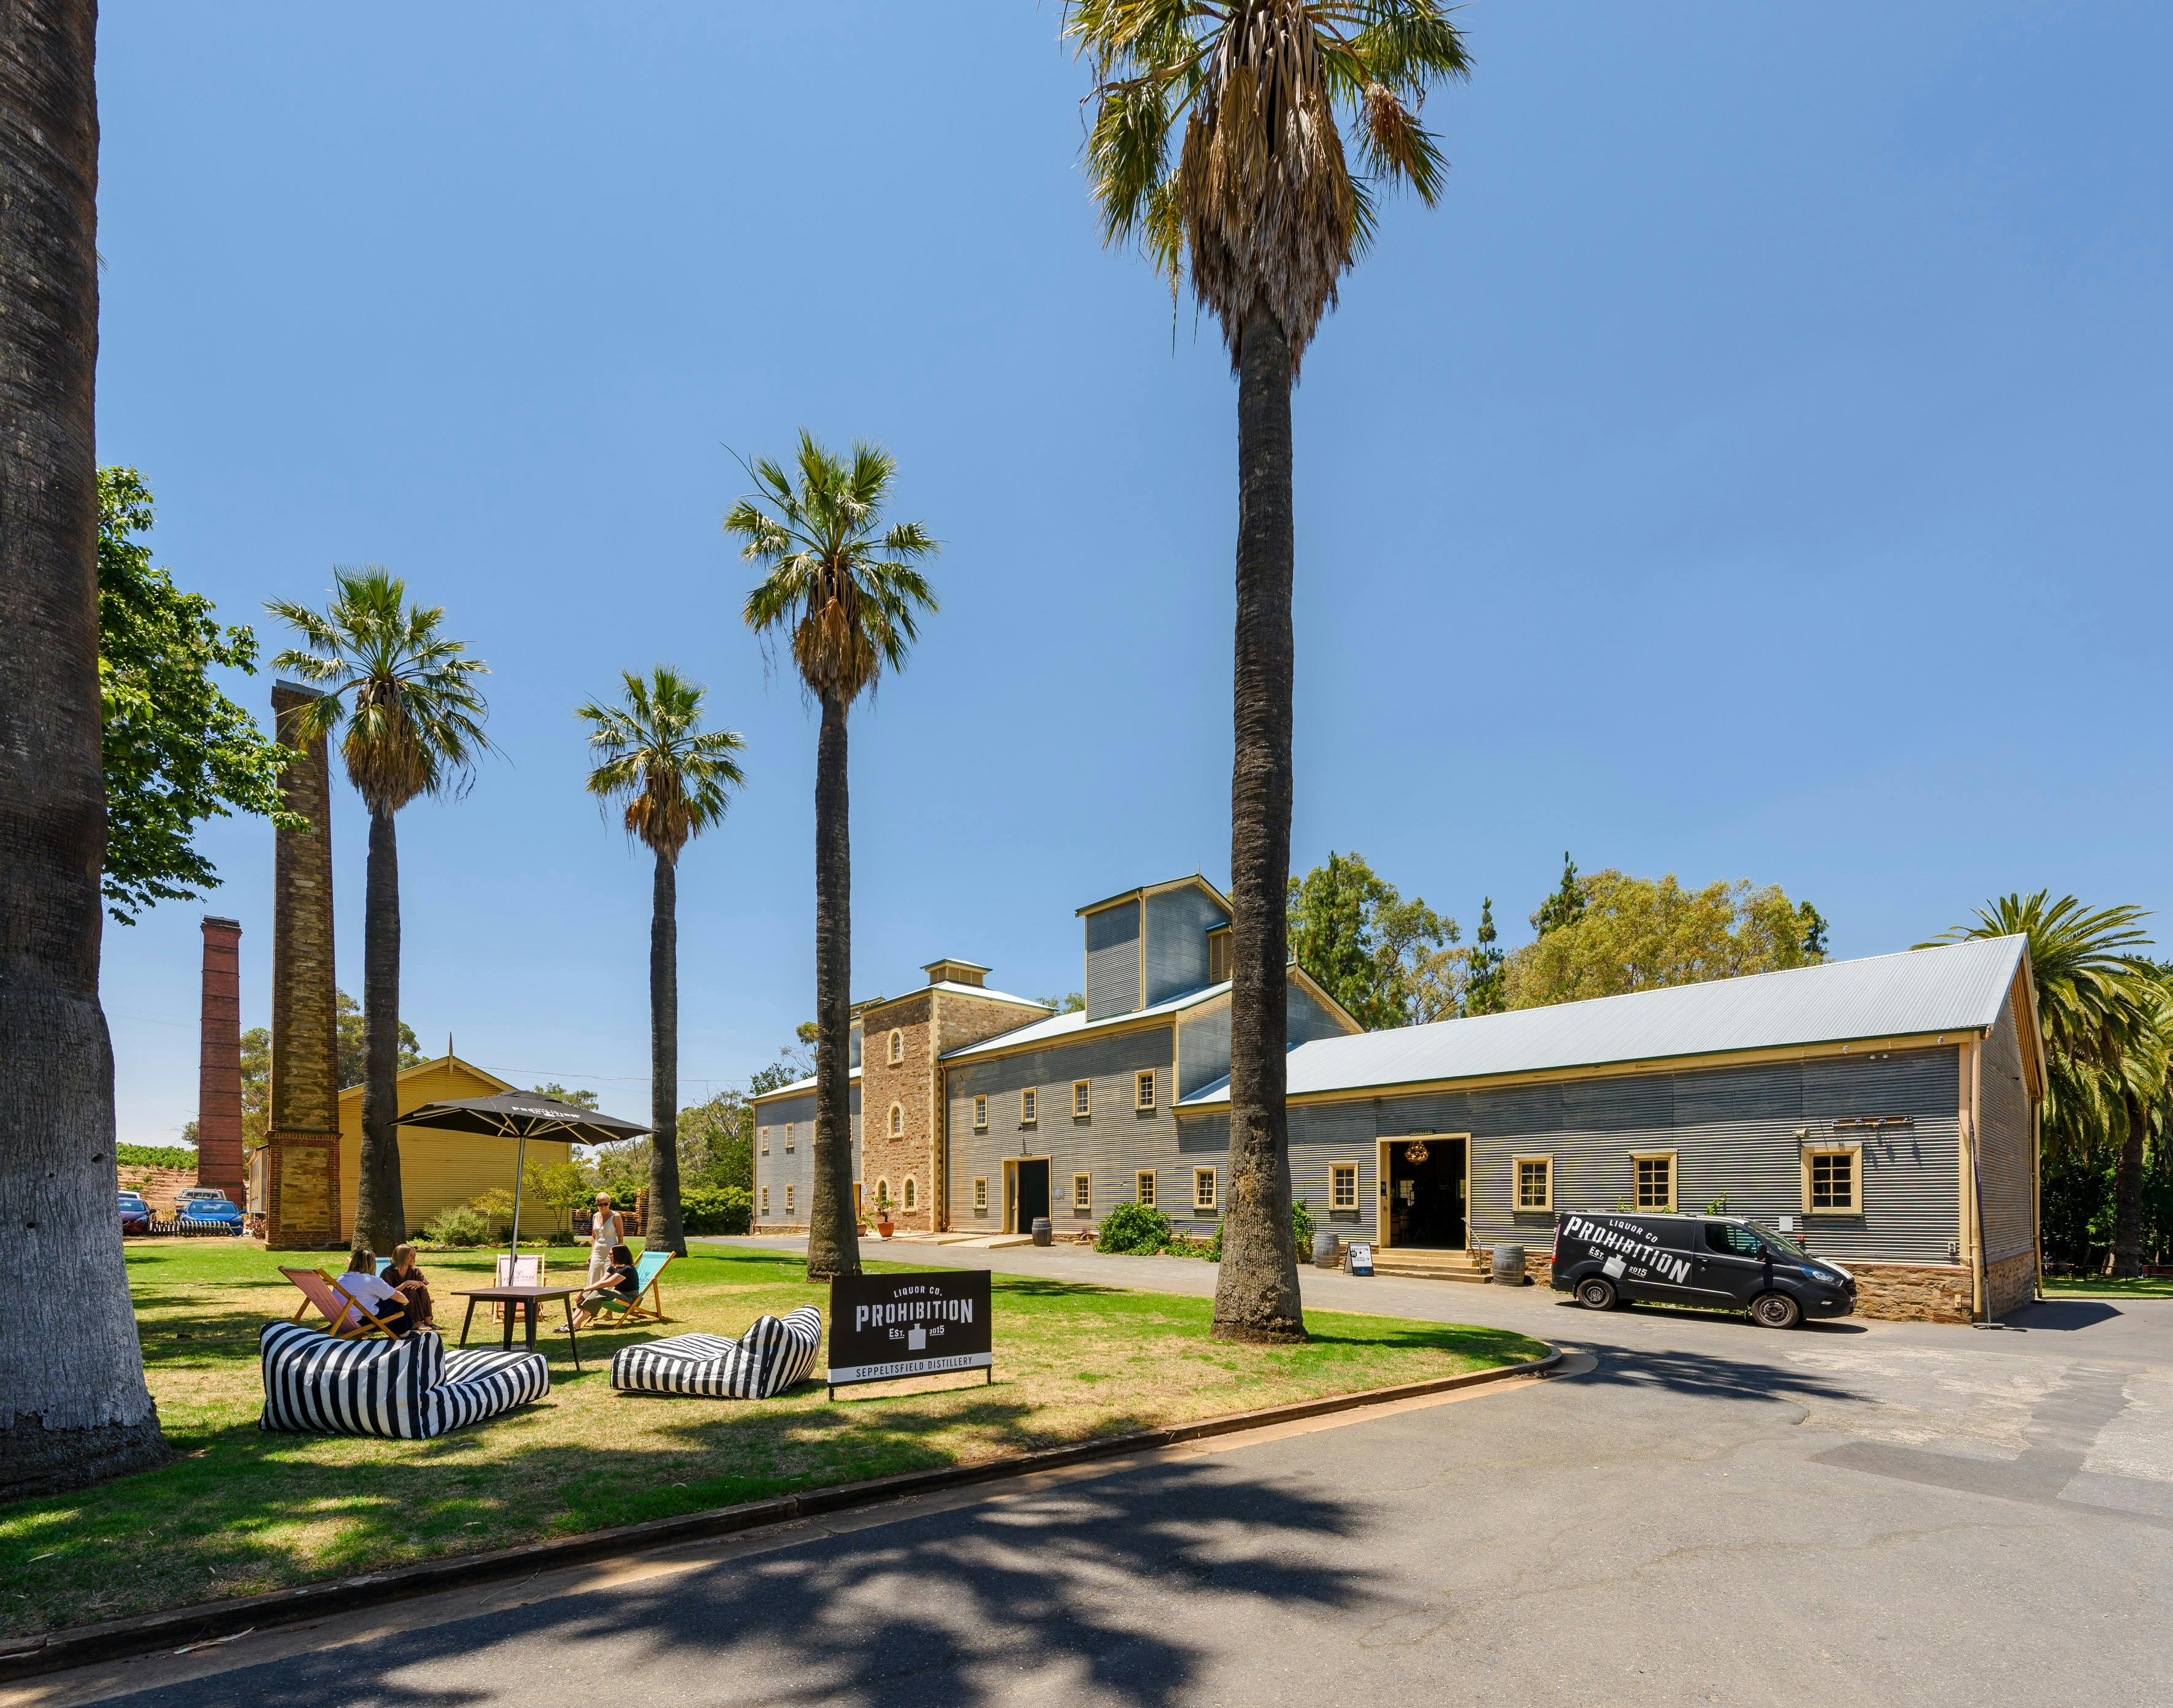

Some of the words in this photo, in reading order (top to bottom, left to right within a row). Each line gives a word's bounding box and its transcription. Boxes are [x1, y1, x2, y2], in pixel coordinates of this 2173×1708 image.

[1609, 1219, 1644, 1235] LIQUOR
[1563, 1216, 1691, 1284] PROHIBITION
[1629, 1266, 1647, 1277] 2015
[894, 1286, 925, 1298] LIQUOR
[929, 1287, 942, 1296] CO.
[856, 1298, 973, 1332] PROHIBITION
[929, 1325, 945, 1334] 2015
[856, 1361, 924, 1378] SEPPELTSFIELD
[928, 1356, 973, 1369] DISTILLERY
